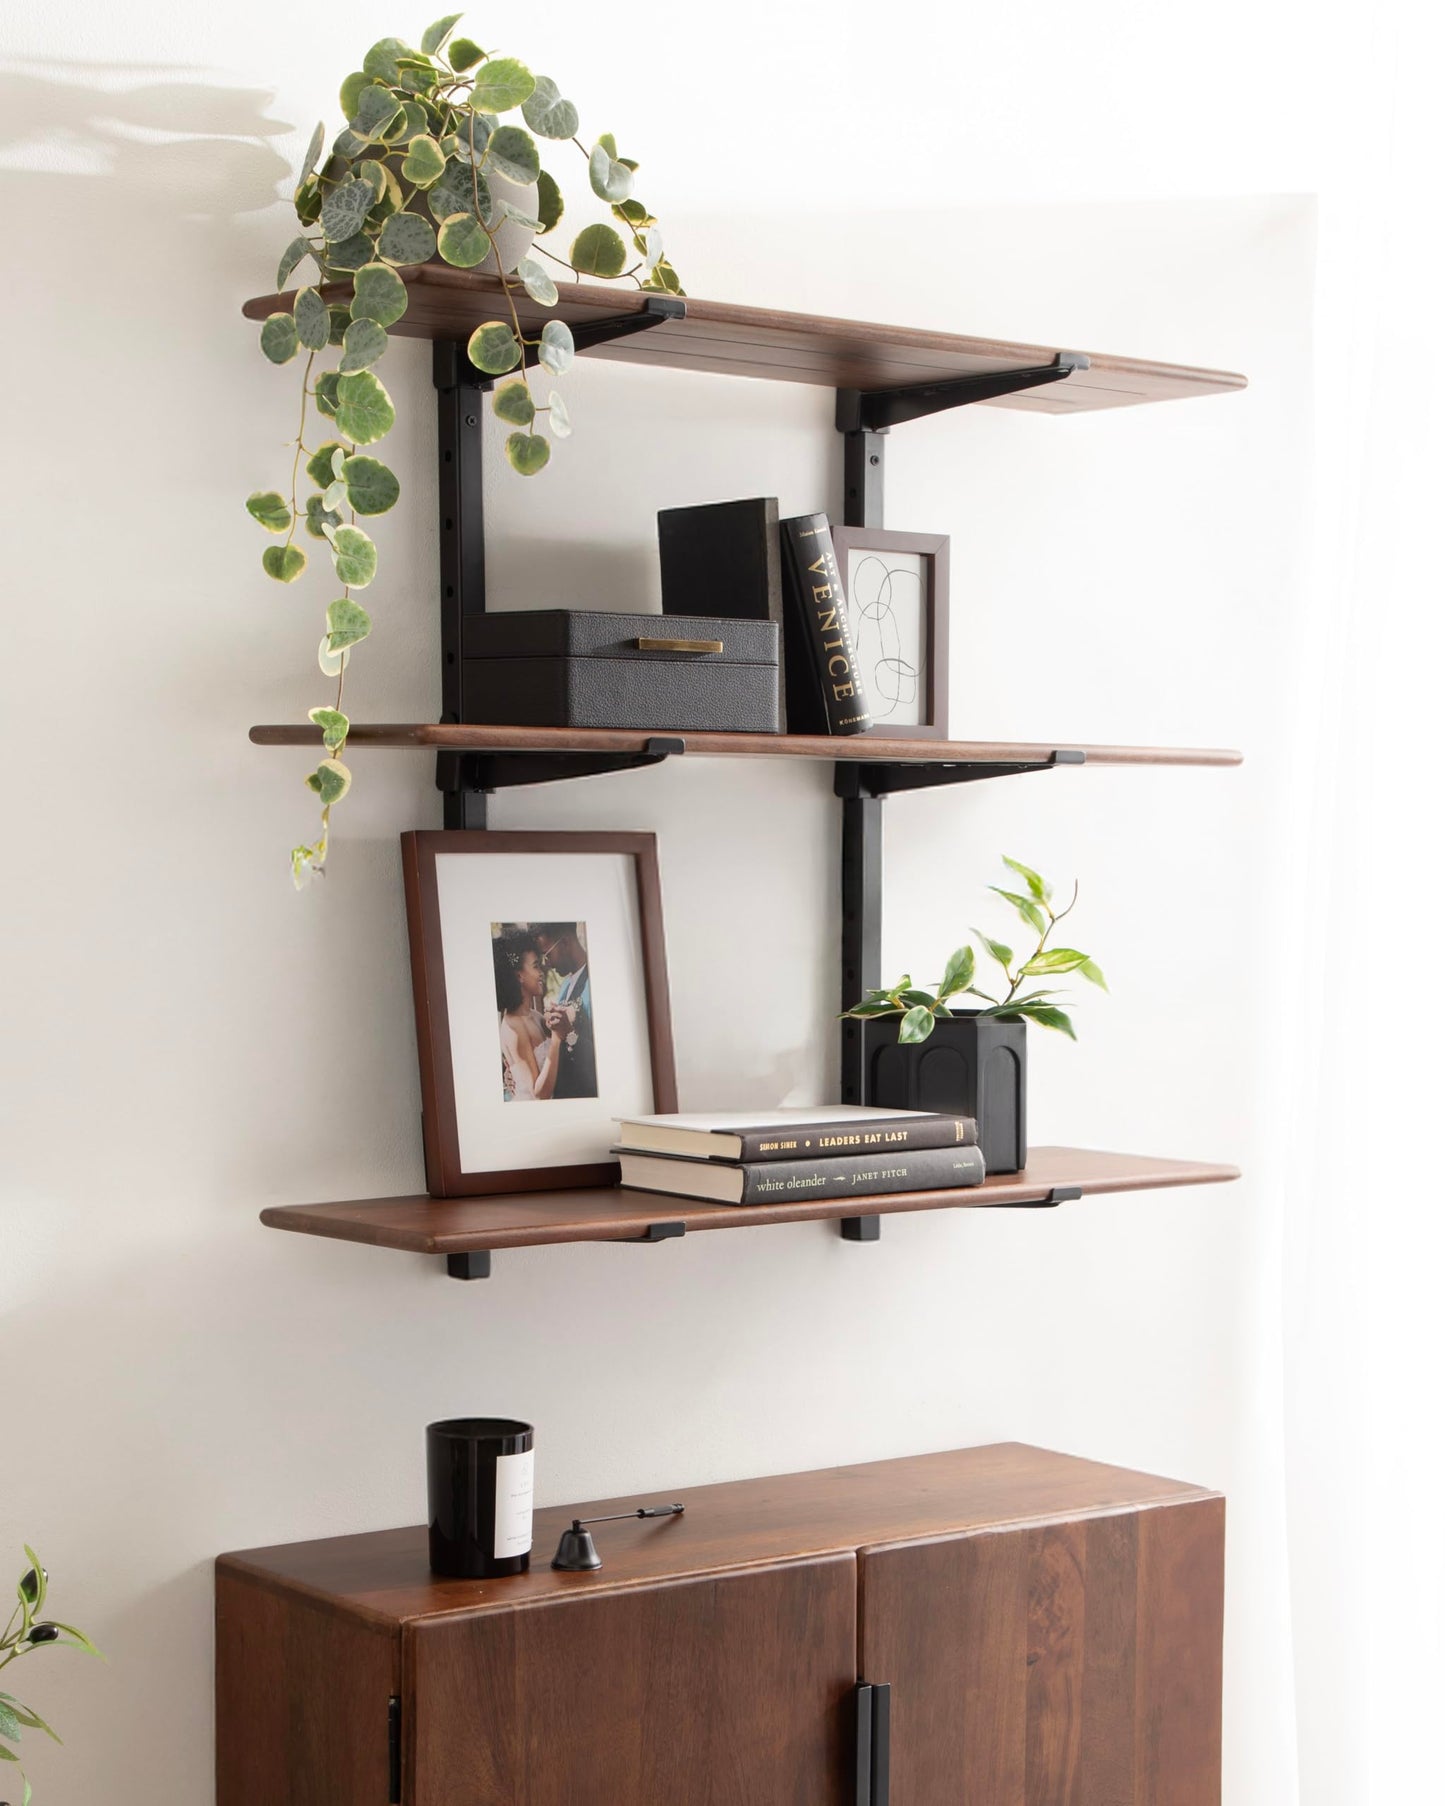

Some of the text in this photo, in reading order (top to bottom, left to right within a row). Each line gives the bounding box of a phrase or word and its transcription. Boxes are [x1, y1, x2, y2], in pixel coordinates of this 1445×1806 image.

[808, 555, 855, 702] VENICE
[825, 552, 836, 577] ART
[836, 598, 863, 695] ARCHITECTURE
[757, 1168, 908, 1192] white oleander JANET FITCH
[759, 1142, 779, 1151] SIMON
[819, 1135, 861, 1147] LEADERS
[864, 1133, 882, 1143] EAT
[885, 1131, 908, 1142] LAST
